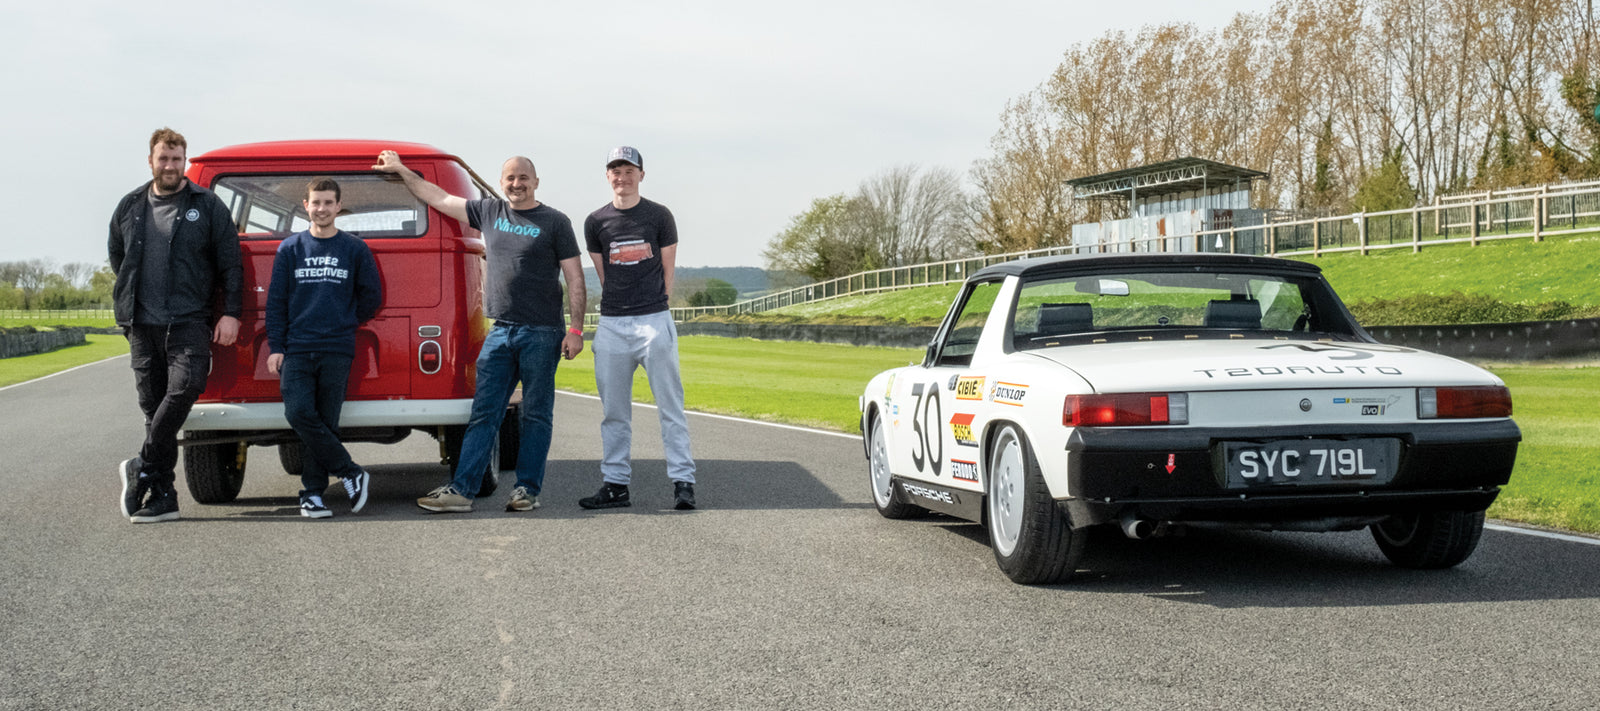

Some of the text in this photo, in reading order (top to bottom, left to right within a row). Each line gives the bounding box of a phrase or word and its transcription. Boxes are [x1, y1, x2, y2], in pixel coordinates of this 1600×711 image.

[294, 267, 349, 279] DETECTIVES
[996, 387, 1026, 401] DUNLOP
[911, 381, 943, 477] 30
[954, 424, 972, 441] BOSCH
[1239, 448, 1377, 478] SYC 719L
[902, 482, 954, 505] PORSCHE
